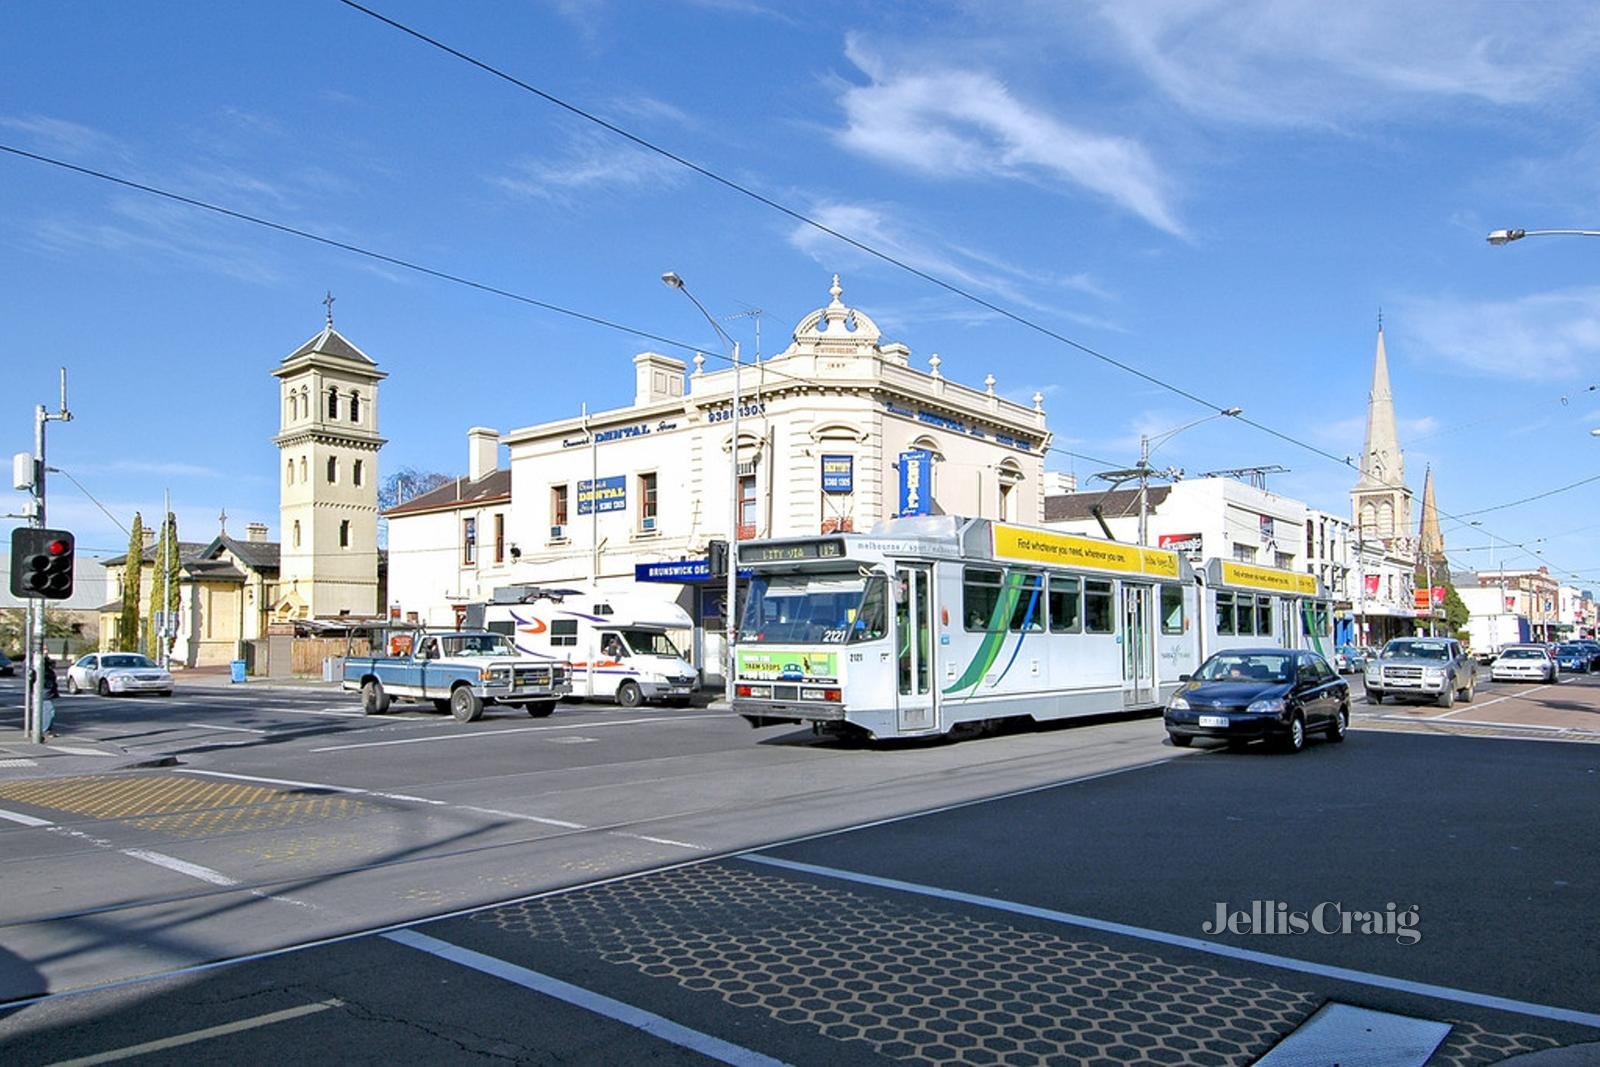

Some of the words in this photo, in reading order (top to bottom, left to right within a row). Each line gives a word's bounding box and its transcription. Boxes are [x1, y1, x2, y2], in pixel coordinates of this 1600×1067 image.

[594, 424, 651, 444] DENTAL
[1018, 538, 1031, 550] Find
[648, 565, 693, 577] BRUNSWICK
[823, 630, 846, 643] 2121
[745, 663, 760, 671] TRAM
